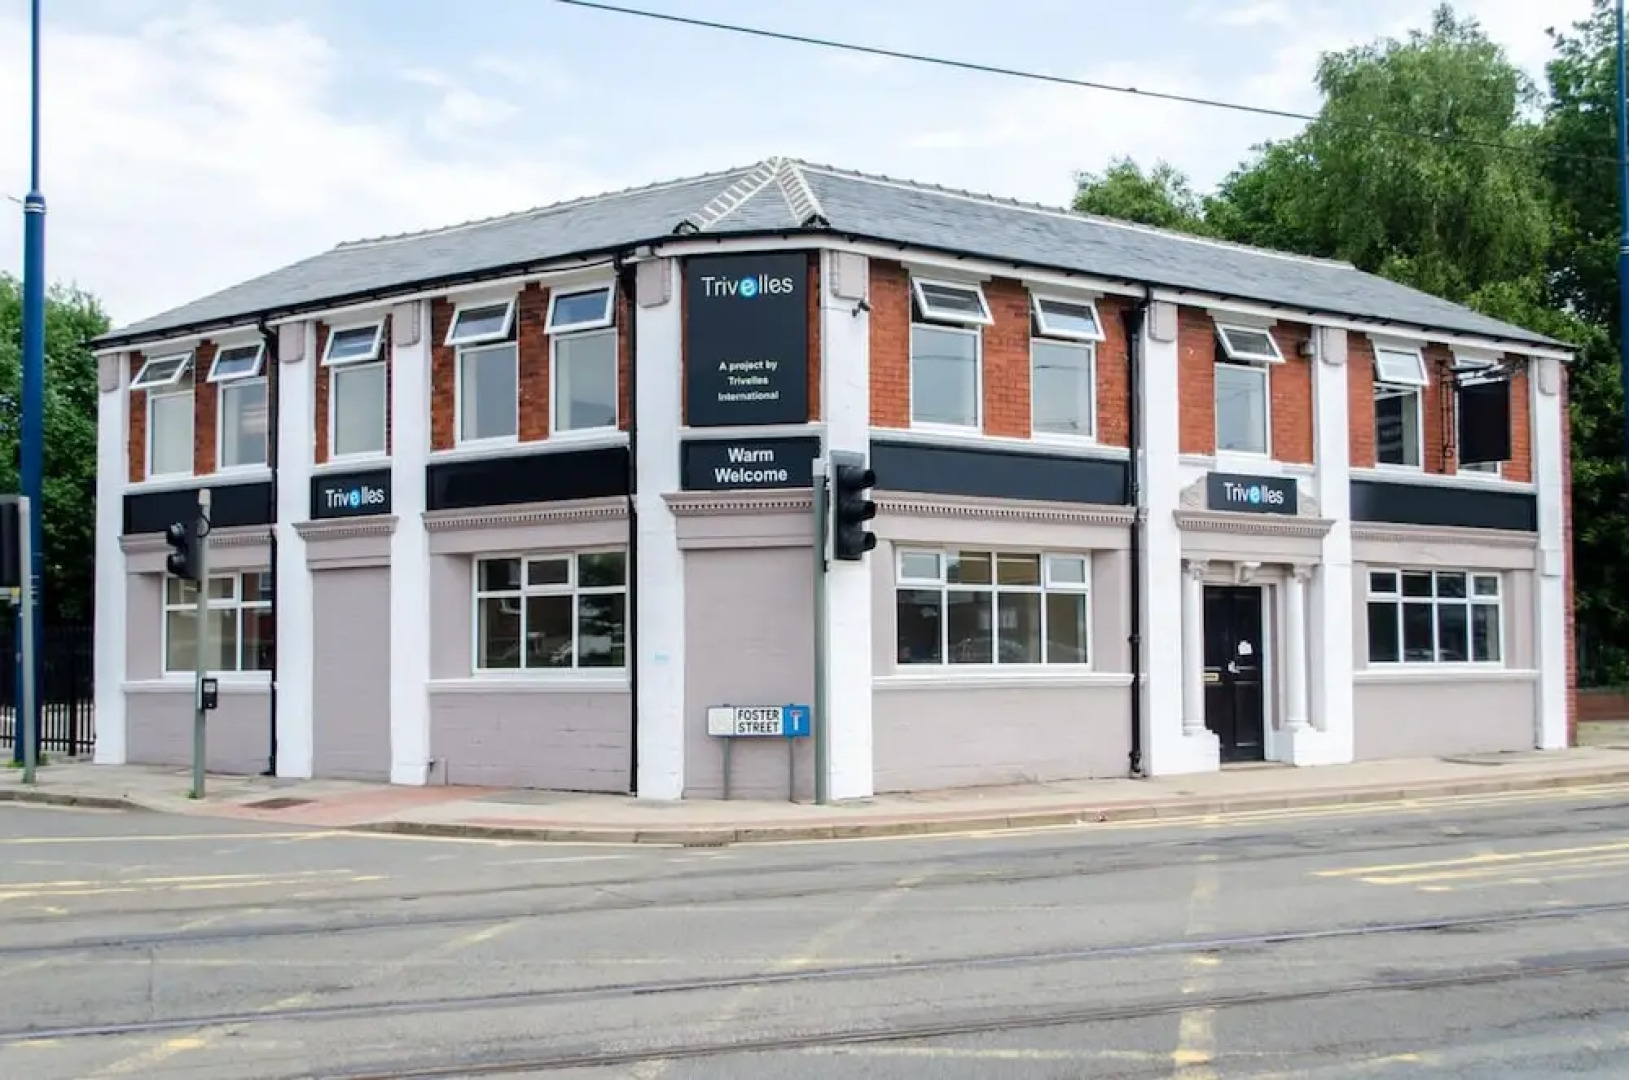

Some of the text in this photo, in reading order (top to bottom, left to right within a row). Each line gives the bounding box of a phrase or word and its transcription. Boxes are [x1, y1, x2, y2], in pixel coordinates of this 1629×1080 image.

[701, 274, 794, 299] Trivelles
[718, 359, 778, 372] A project by
[727, 375, 769, 386] Trivelles
[718, 390, 779, 401] International
[728, 447, 774, 463] Warm
[714, 467, 788, 483] Welcome
[325, 486, 385, 508] Trivelles
[1224, 482, 1284, 505] Trivelles
[737, 709, 780, 721] FOSTER
[737, 721, 780, 733] STREET
